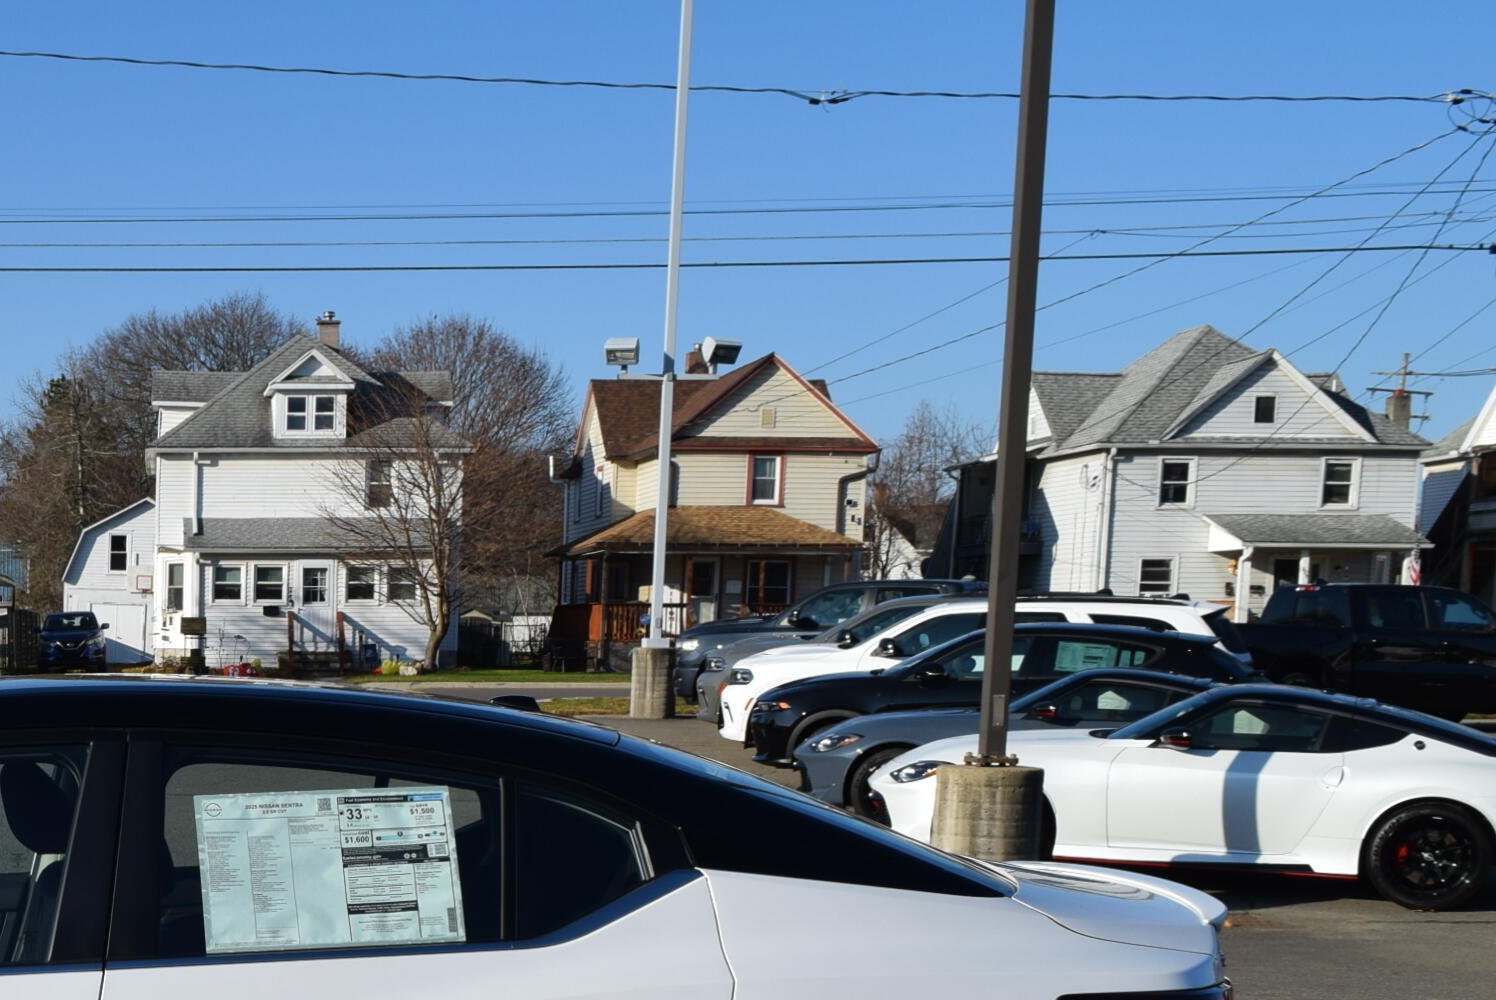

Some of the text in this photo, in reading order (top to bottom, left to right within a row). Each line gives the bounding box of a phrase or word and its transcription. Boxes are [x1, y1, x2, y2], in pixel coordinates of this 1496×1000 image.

[346, 808, 363, 820] 33
[409, 807, 435, 815] $1,500
[344, 835, 370, 844] $1,600
